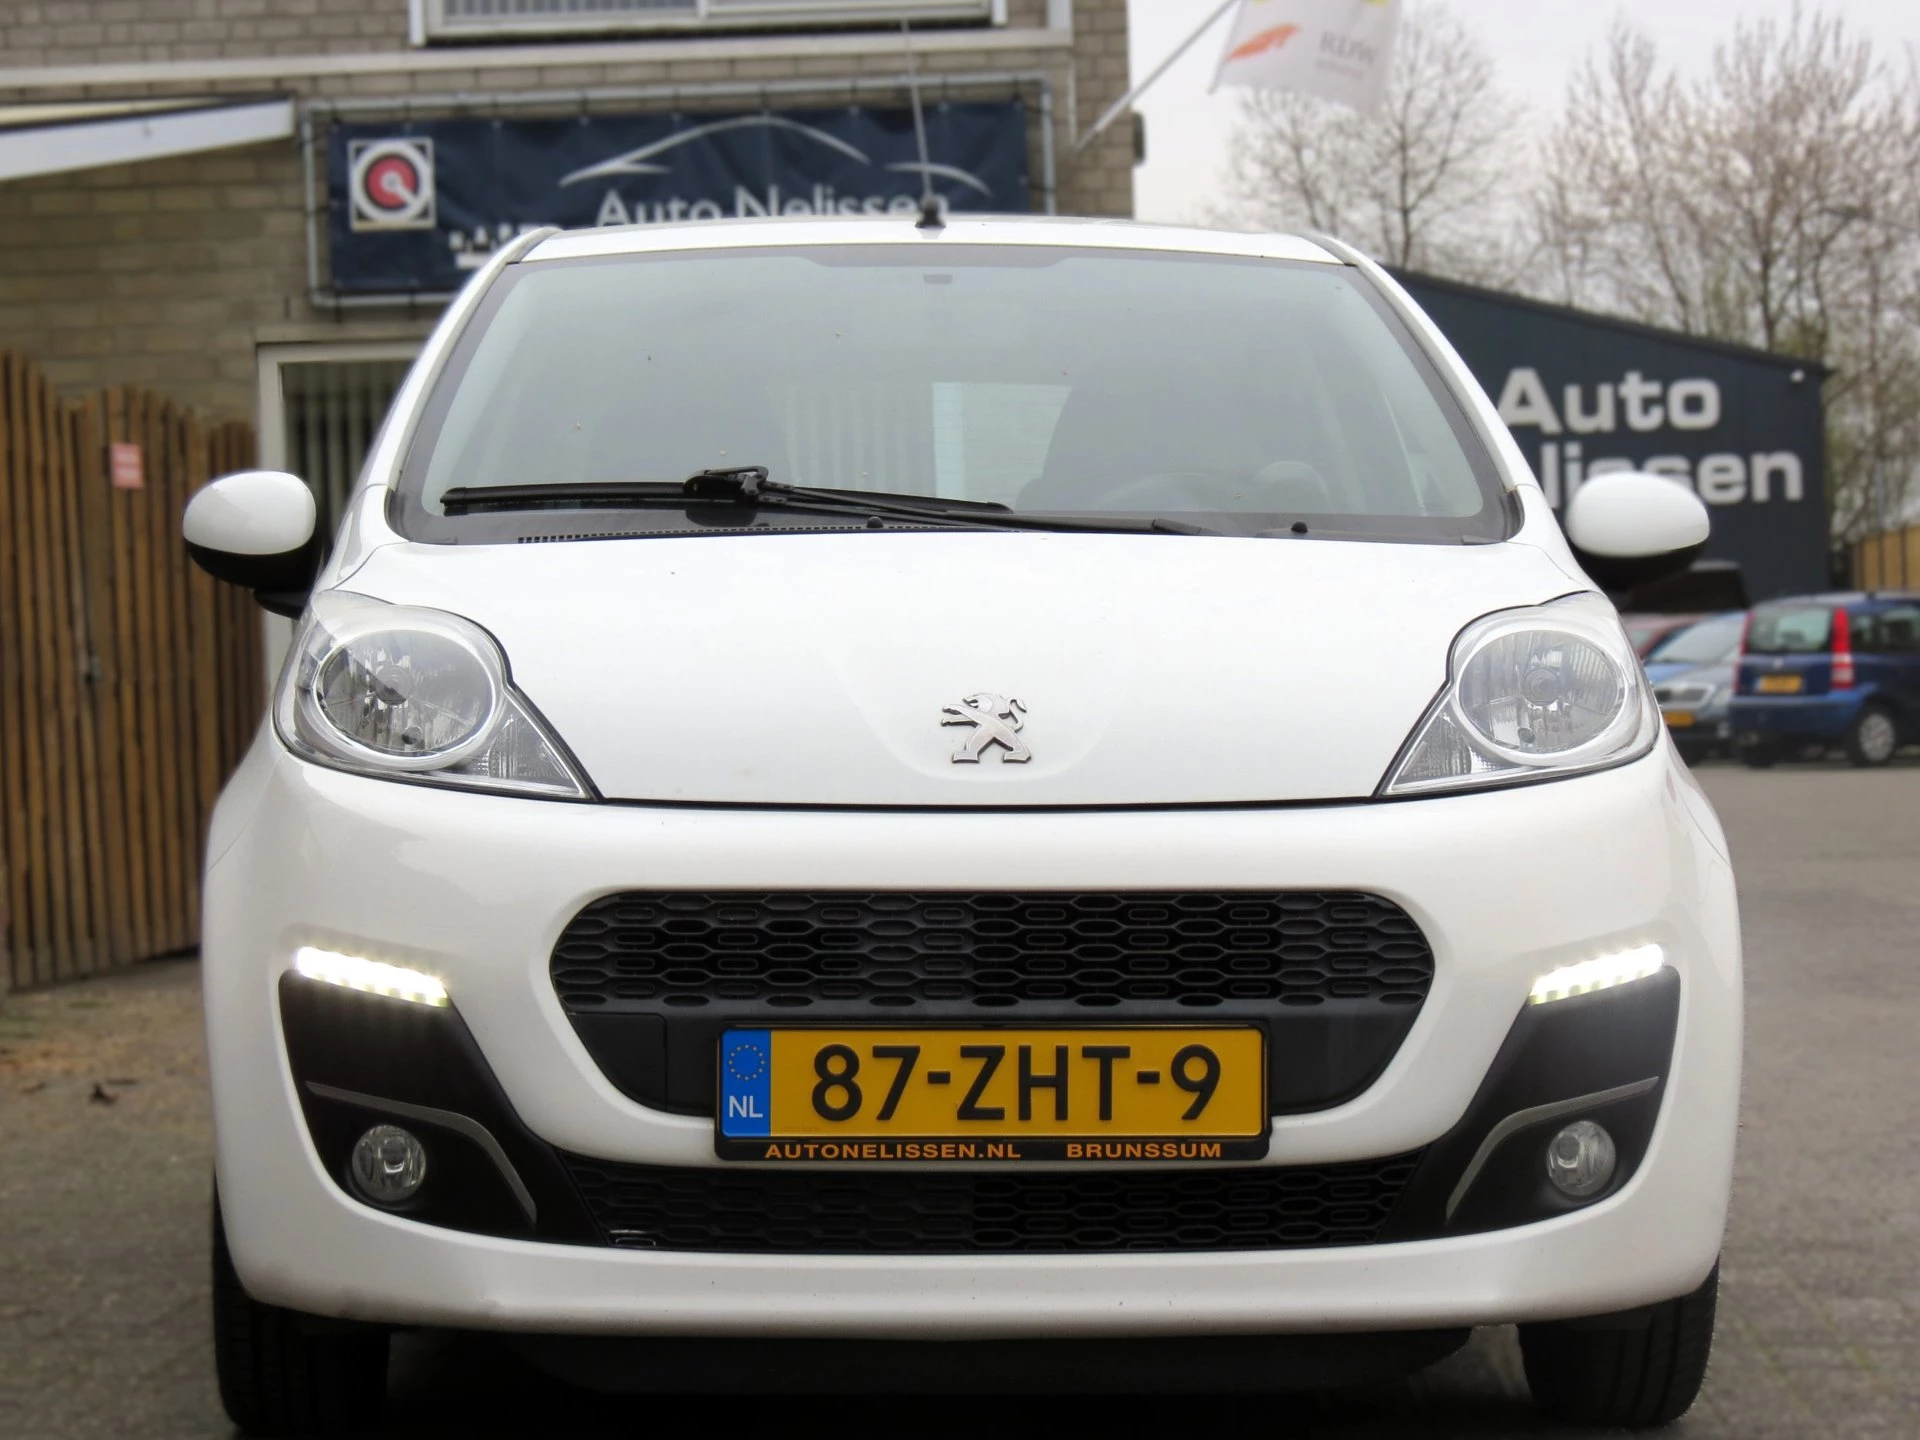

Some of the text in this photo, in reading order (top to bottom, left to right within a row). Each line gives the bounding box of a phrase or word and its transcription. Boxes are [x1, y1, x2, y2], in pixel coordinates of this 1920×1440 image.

[597, 188, 723, 228] Auto
[1498, 366, 1721, 435] Auto
[811, 1043, 1222, 1122] 87-ZHT-9
[728, 1095, 764, 1118] NL
[764, 1142, 1222, 1160] AUTONELISSEN.NL BRUNSSUM
